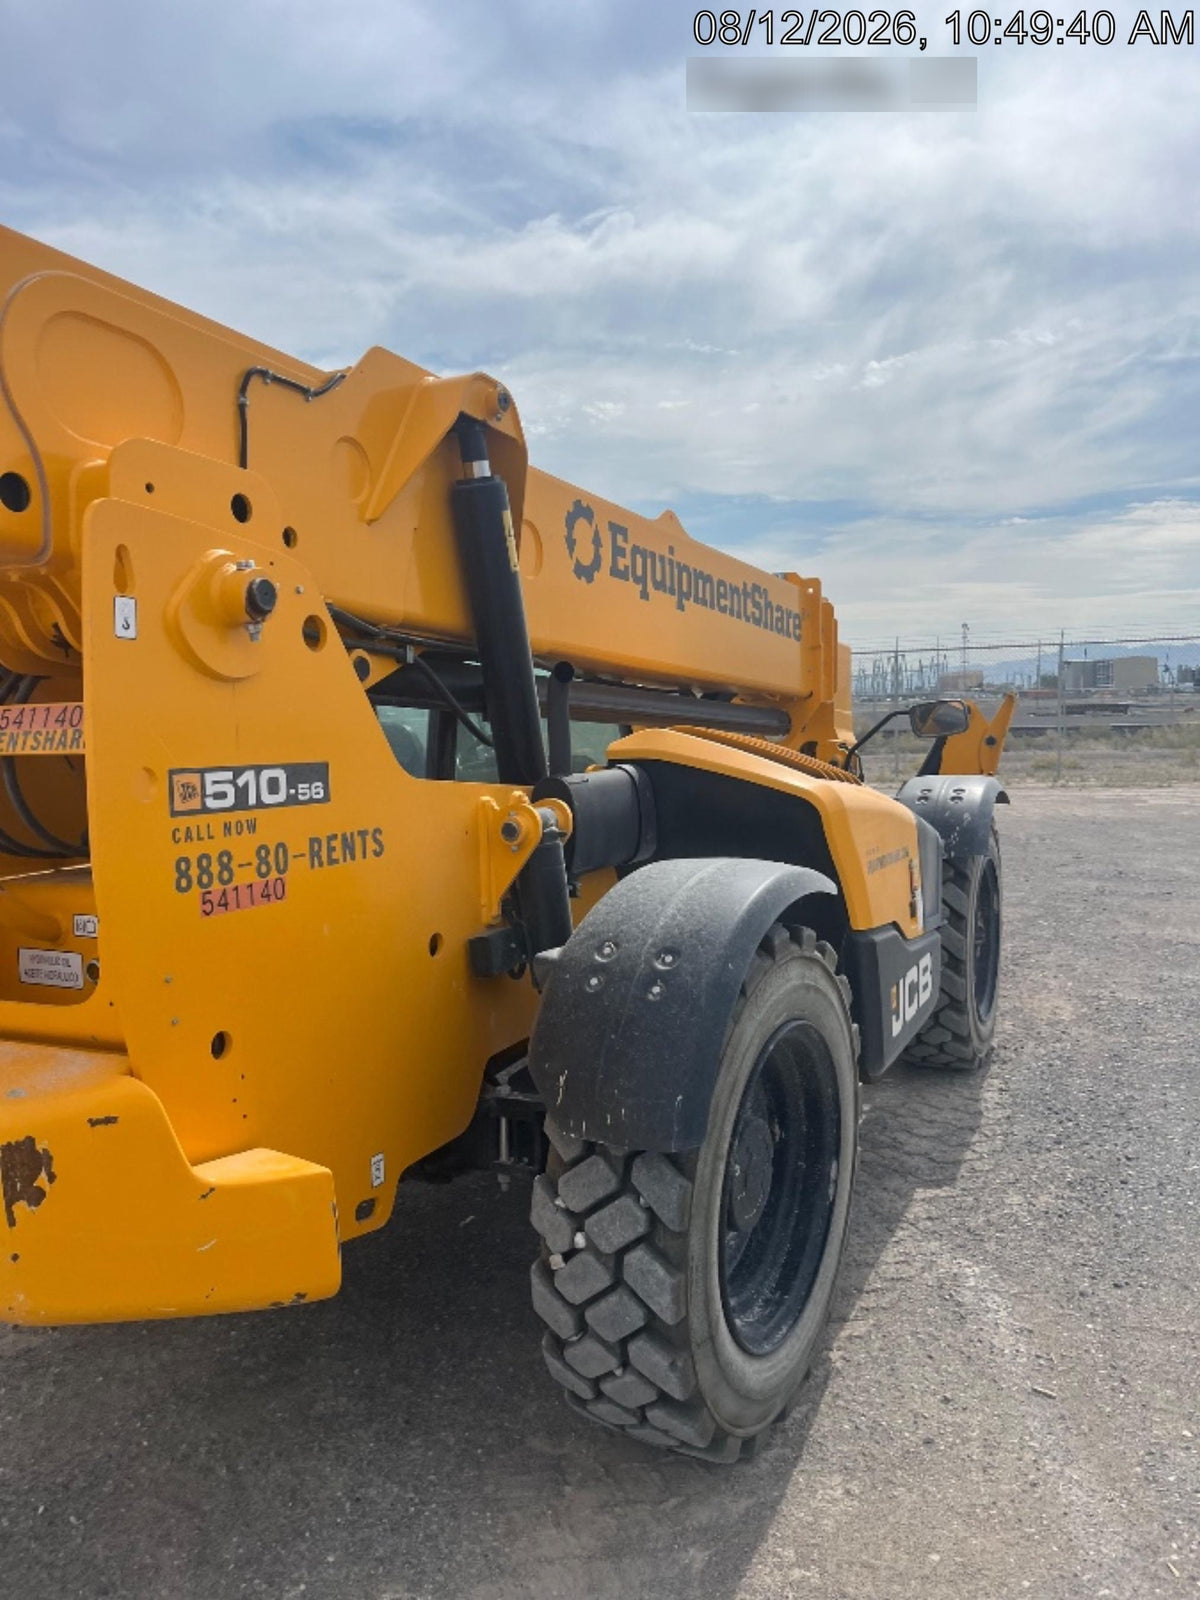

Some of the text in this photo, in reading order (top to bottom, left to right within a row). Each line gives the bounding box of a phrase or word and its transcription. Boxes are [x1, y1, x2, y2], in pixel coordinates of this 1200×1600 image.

[608, 521, 802, 642] EquipmentShare
[0, 705, 83, 730] 541140
[0, 728, 86, 753] ENTSHAR
[172, 818, 257, 844] CALL NOW
[175, 827, 385, 893] 888-80-RENTS
[202, 877, 286, 916] 541140
[891, 952, 932, 1037] JCB
